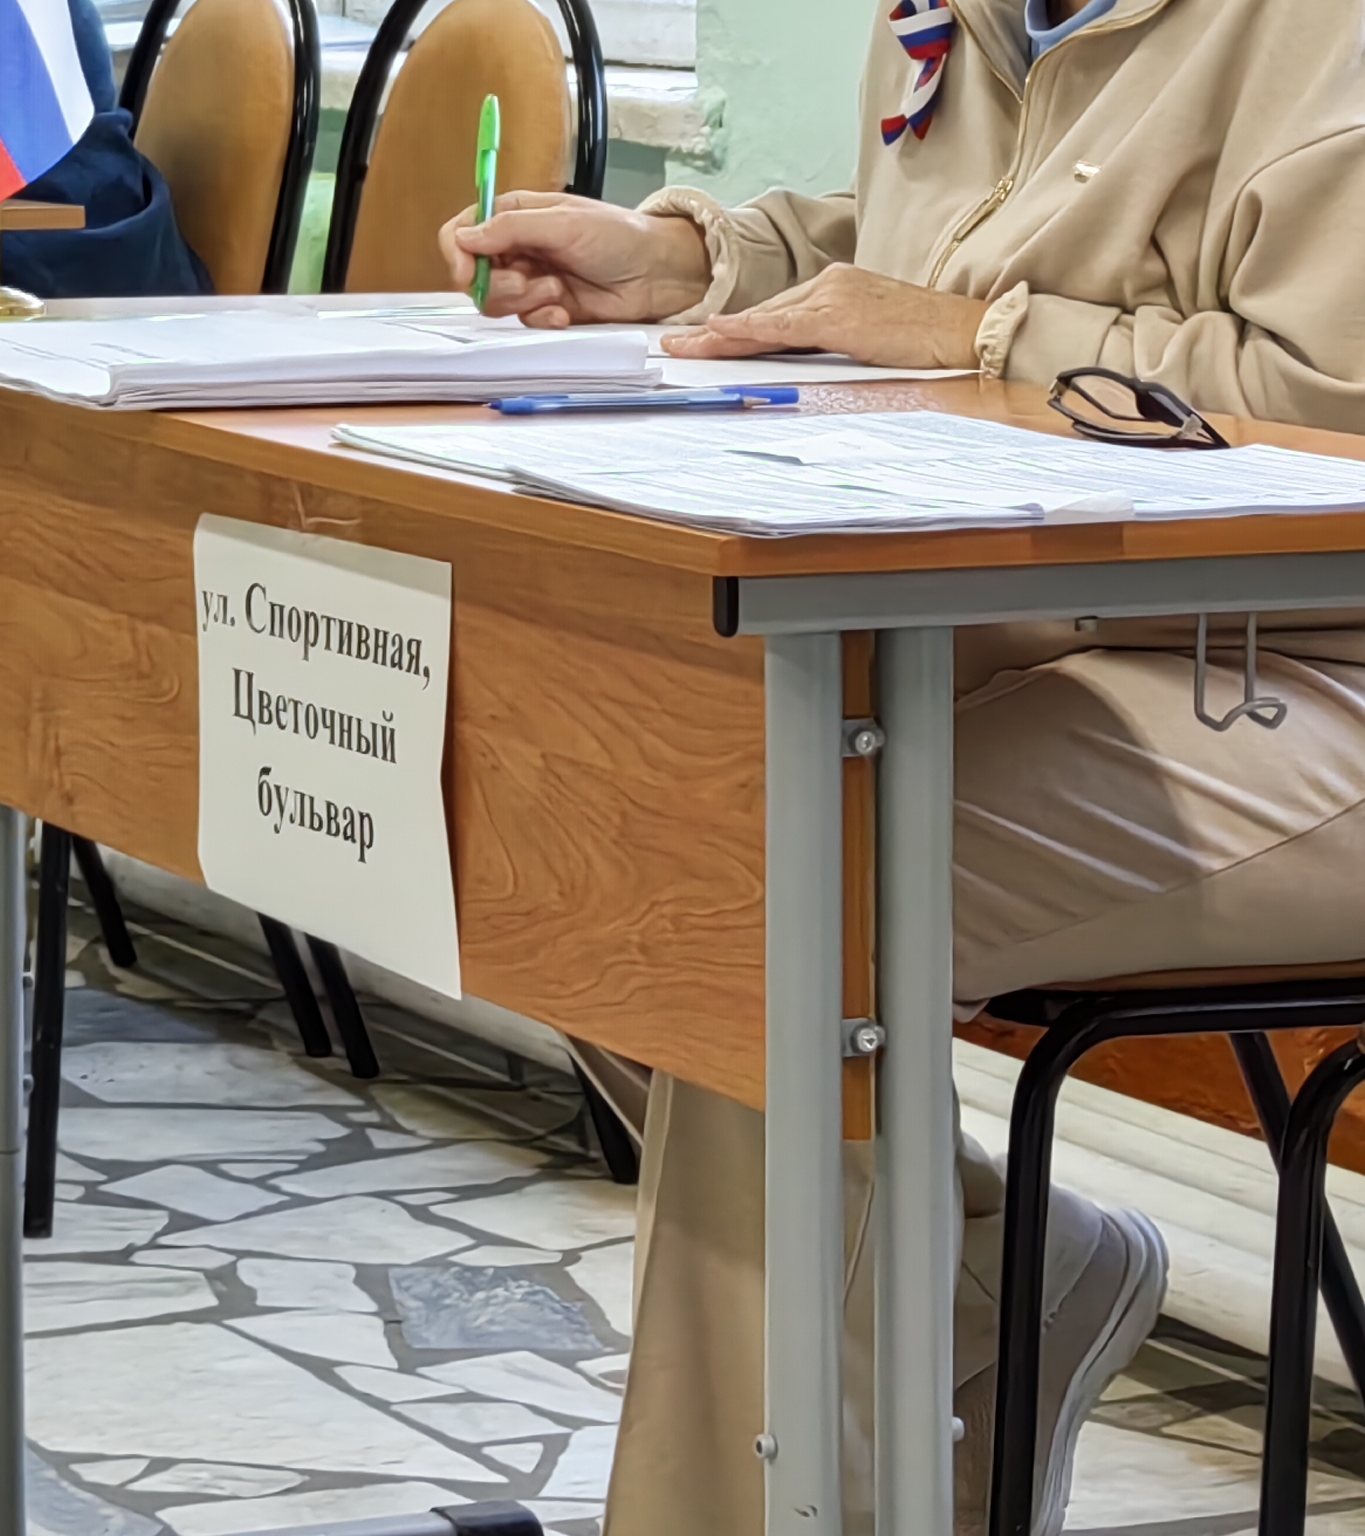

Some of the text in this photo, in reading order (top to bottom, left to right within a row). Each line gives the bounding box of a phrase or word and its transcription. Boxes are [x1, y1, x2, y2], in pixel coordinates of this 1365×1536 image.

[201, 581, 432, 691] ул. Спортивная,
[231, 667, 398, 765] Цветочный
[257, 766, 376, 864] бульвар
